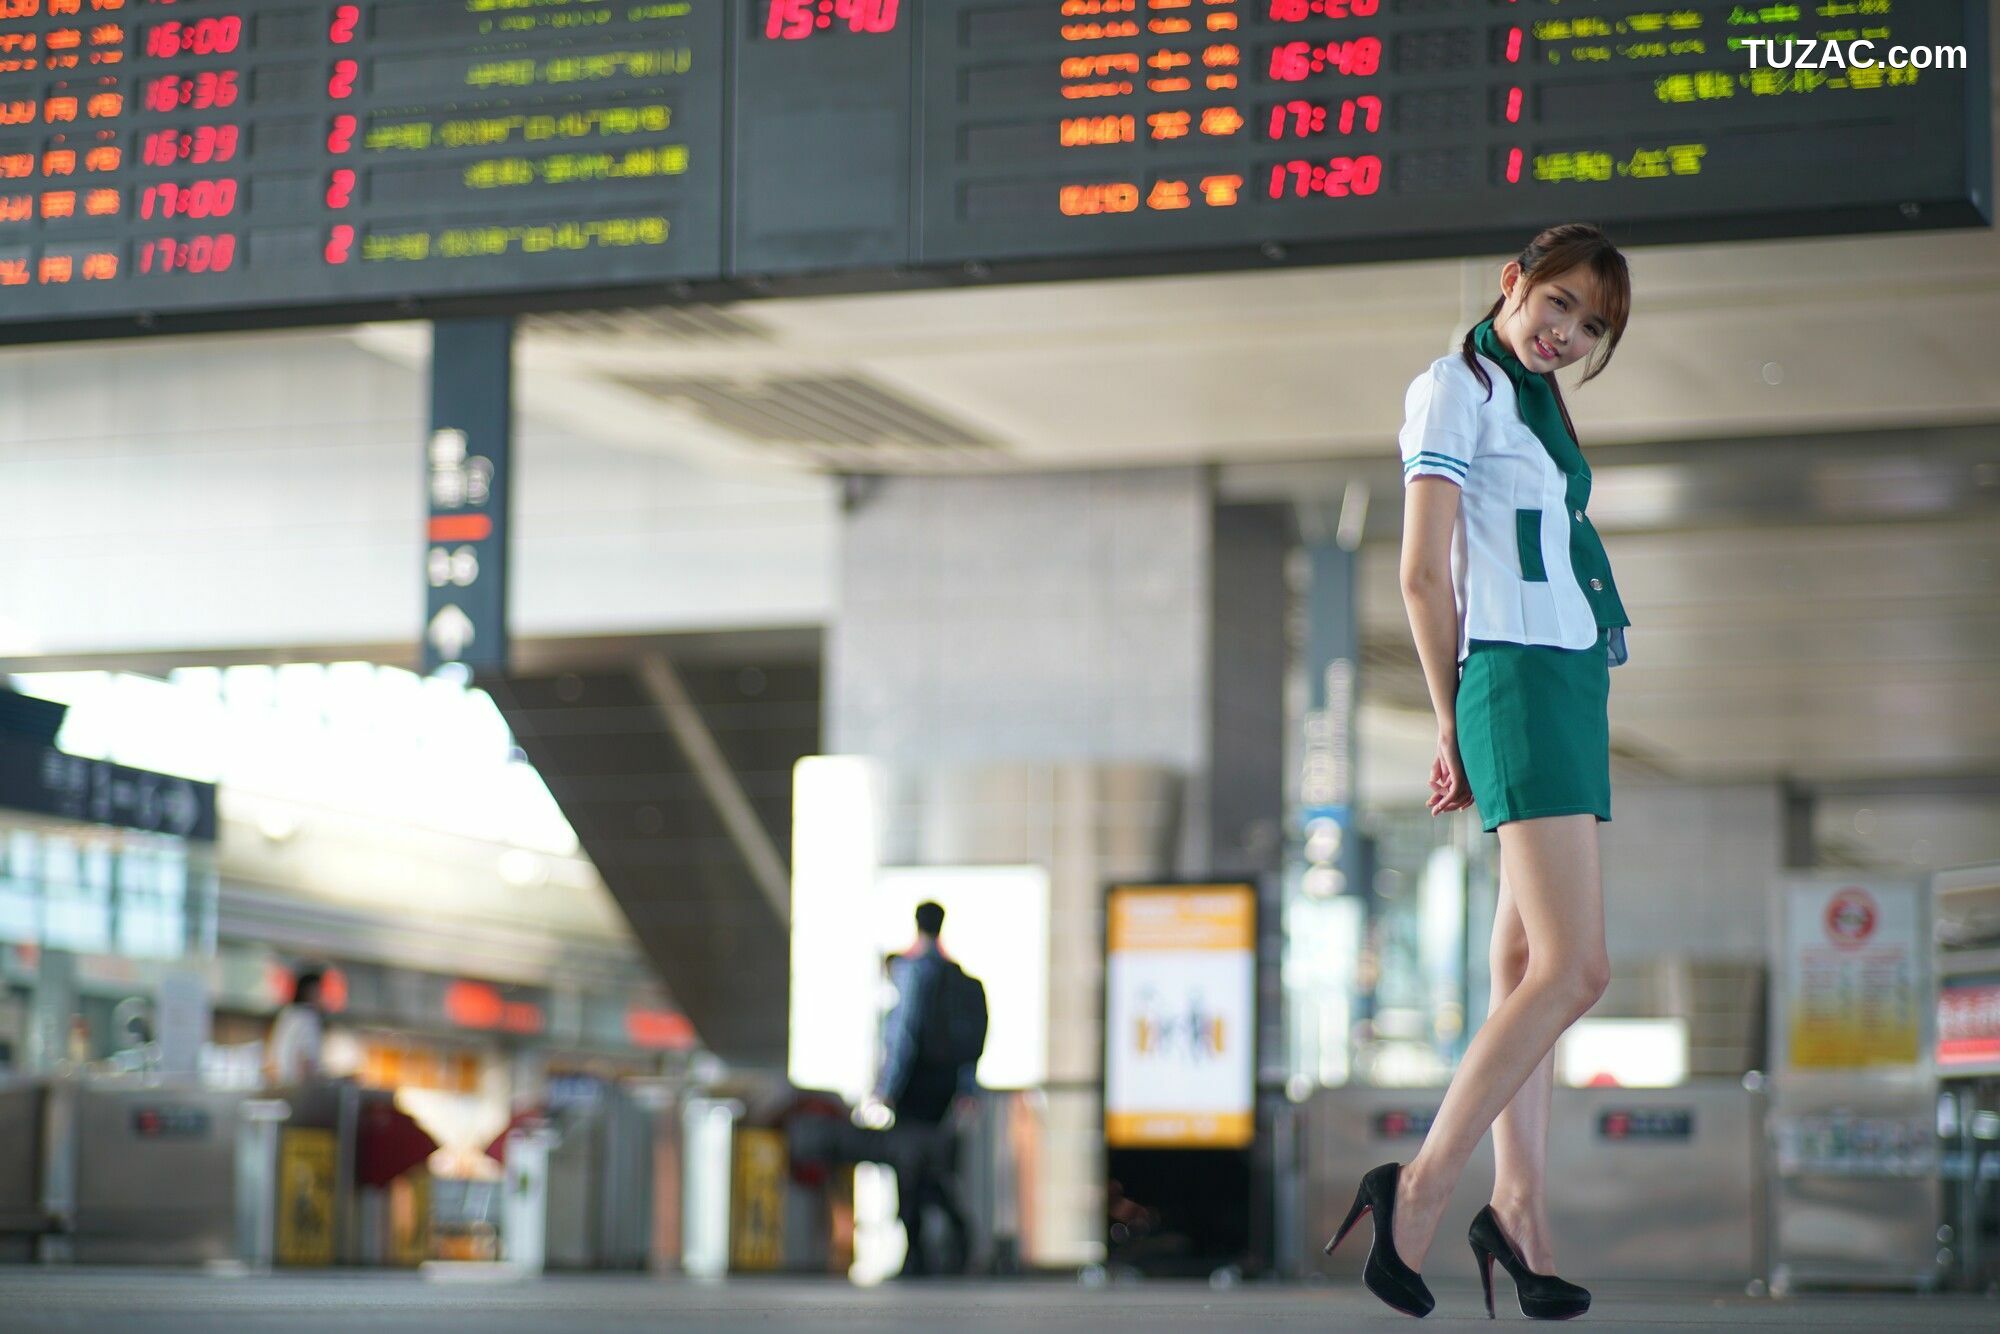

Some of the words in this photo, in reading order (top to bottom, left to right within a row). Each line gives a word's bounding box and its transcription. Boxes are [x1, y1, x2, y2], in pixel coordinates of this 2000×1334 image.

[146, 15, 241, 58] 16:00
[329, 5, 360, 44] 2
[765, 0, 900, 40] 15:40
[1269, 36, 1382, 82] 16:48
[1505, 27, 1523, 63] 1
[145, 70, 239, 113] 16:36
[328, 59, 360, 99] 2
[1269, 95, 1382, 140] 17:17
[1505, 87, 1523, 123] 1
[143, 124, 239, 167] 16:39
[327, 114, 357, 154] 2
[140, 178, 237, 220] 17:00
[326, 169, 356, 209] 2
[1269, 155, 1382, 199] 17:20
[1505, 147, 1523, 184] 1
[325, 224, 355, 264] 2
